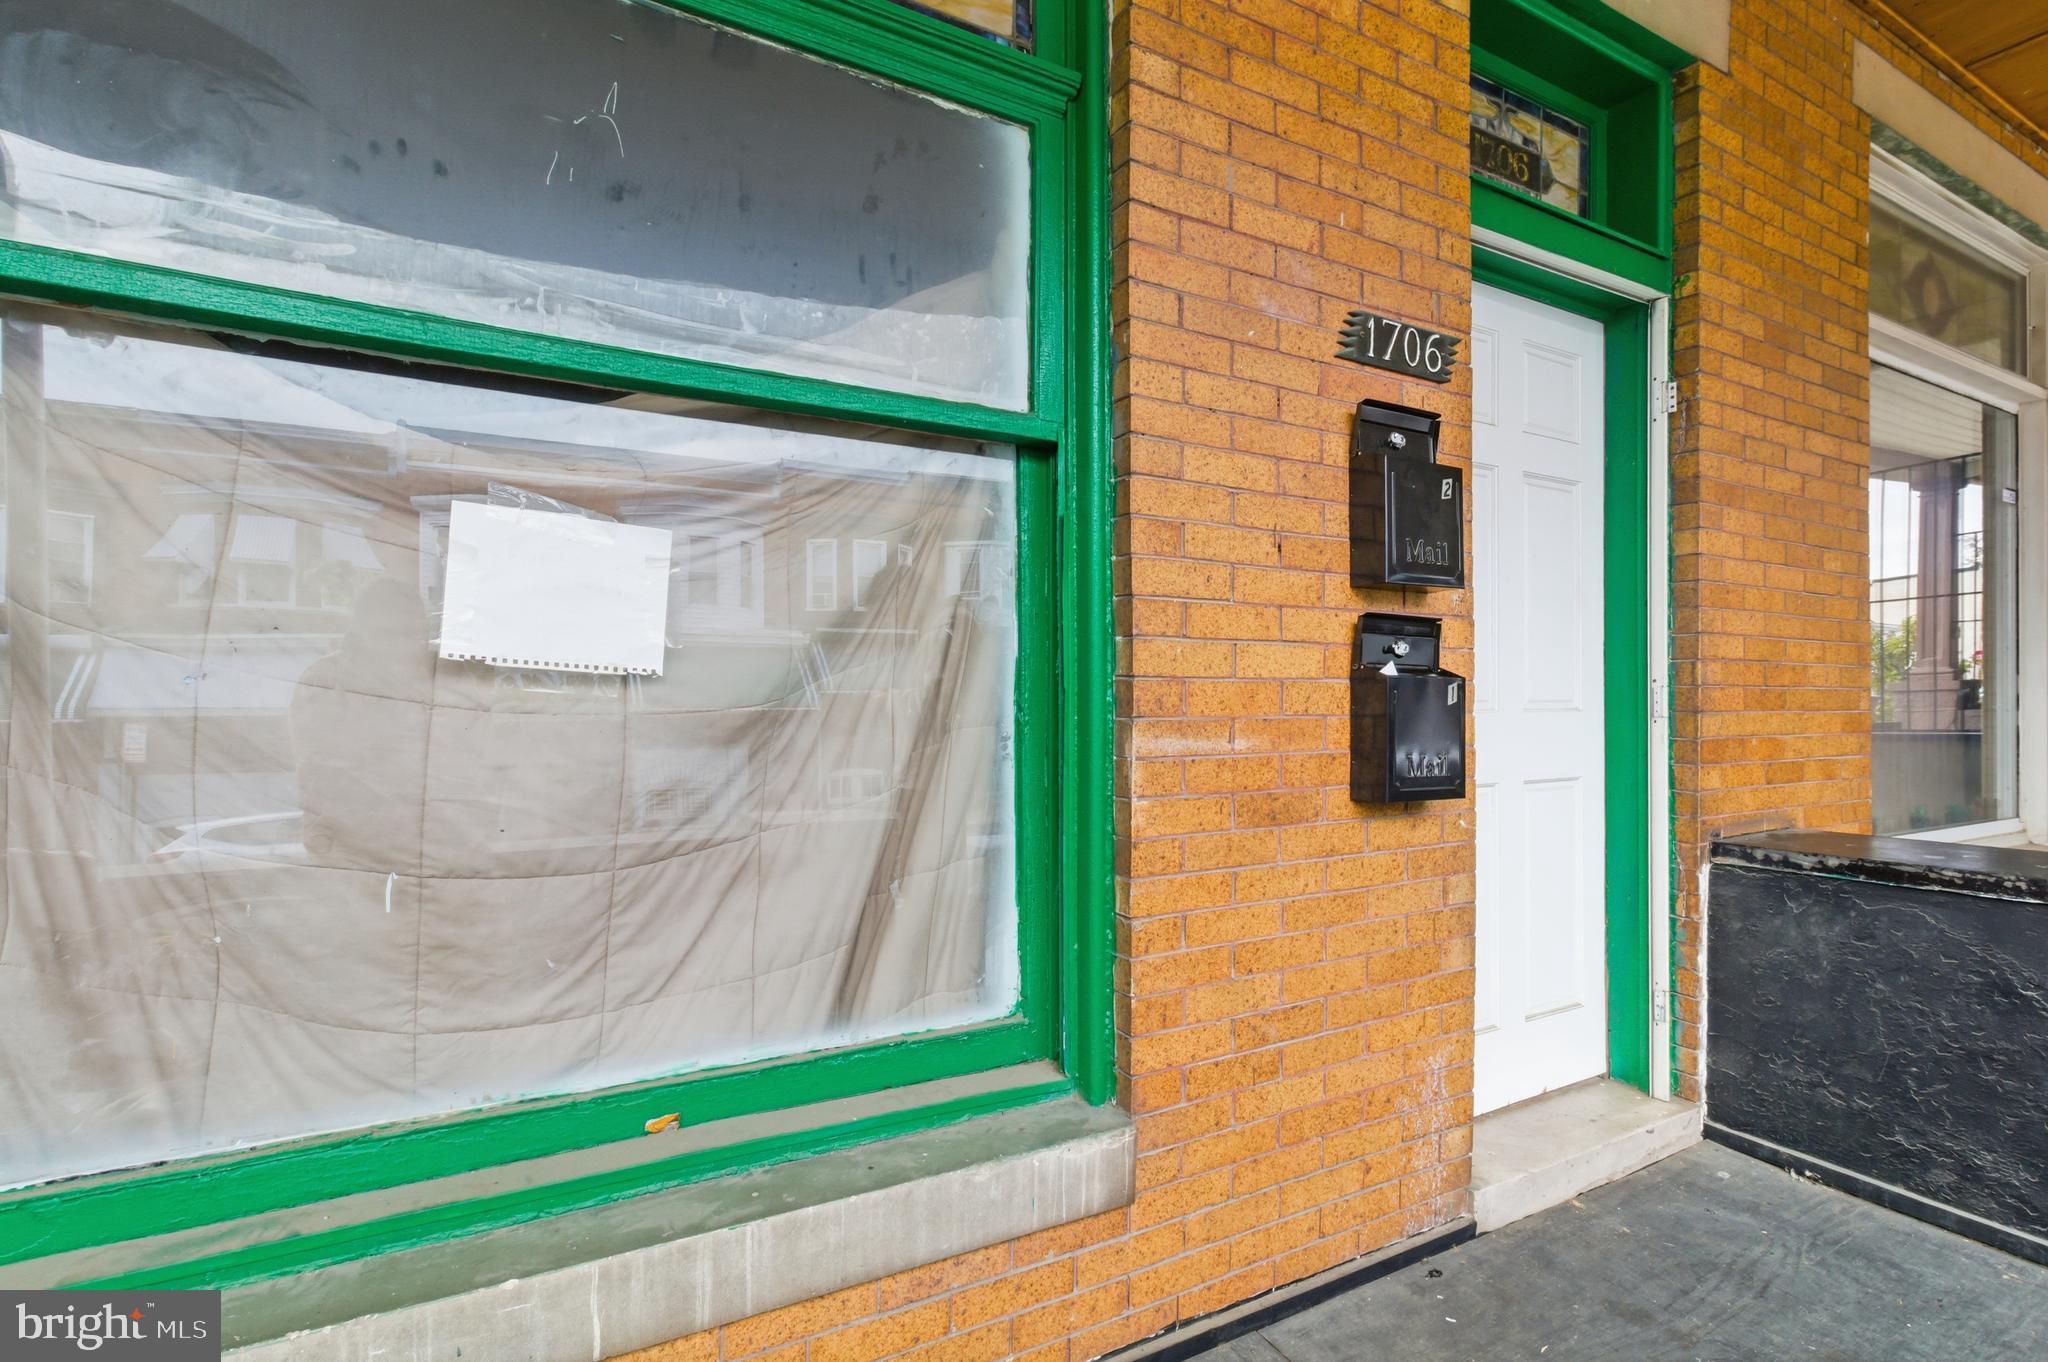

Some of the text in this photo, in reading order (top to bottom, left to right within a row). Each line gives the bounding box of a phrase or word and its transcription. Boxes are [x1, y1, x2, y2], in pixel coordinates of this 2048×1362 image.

[1368, 317, 1442, 373] 1706
[1443, 481, 1451, 497] 2
[1405, 537, 1449, 566] Mail
[1406, 752, 1450, 777] Mail
